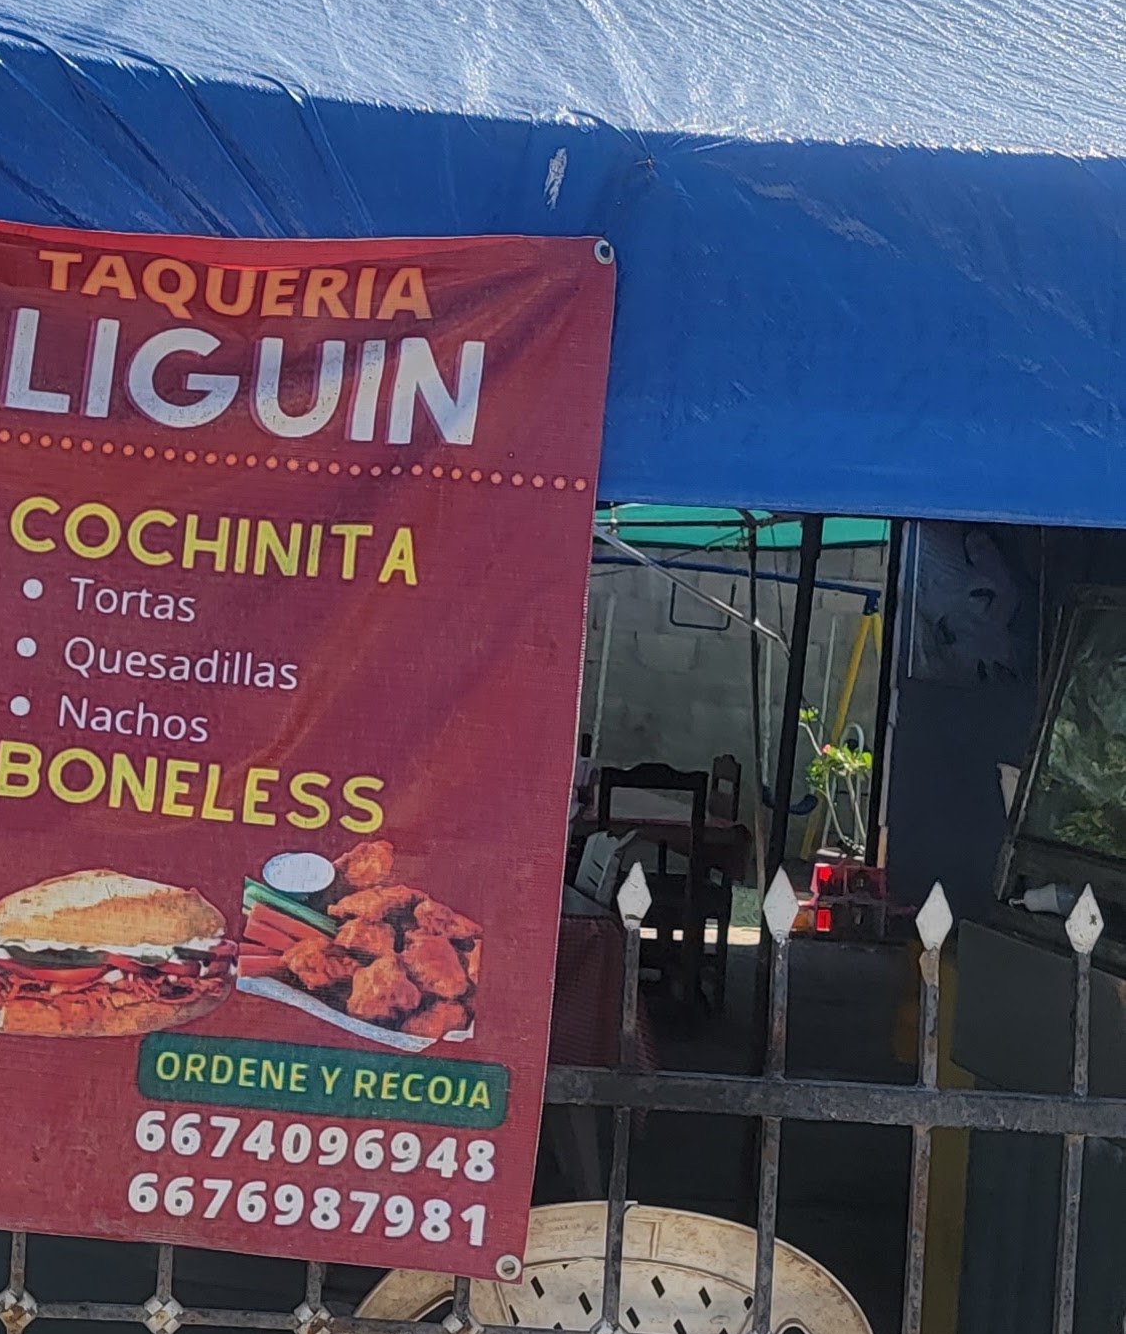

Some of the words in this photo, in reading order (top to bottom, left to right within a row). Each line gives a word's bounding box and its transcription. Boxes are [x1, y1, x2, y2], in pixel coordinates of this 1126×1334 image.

[39, 251, 432, 319] TAQUERIA
[1, 308, 485, 446] LIGUIN
[10, 497, 417, 586] COCHINITA
[70, 578, 196, 623] Tortas
[64, 637, 298, 691] Quesadillas
[59, 695, 209, 743] Nachos
[156, 1051, 309, 1092] ORDENE
[321, 1067, 341, 1095] Y
[353, 1069, 491, 1109] RECOJA
[135, 1110, 495, 1182] 6674096948
[127, 1173, 486, 1246] 6676987981
